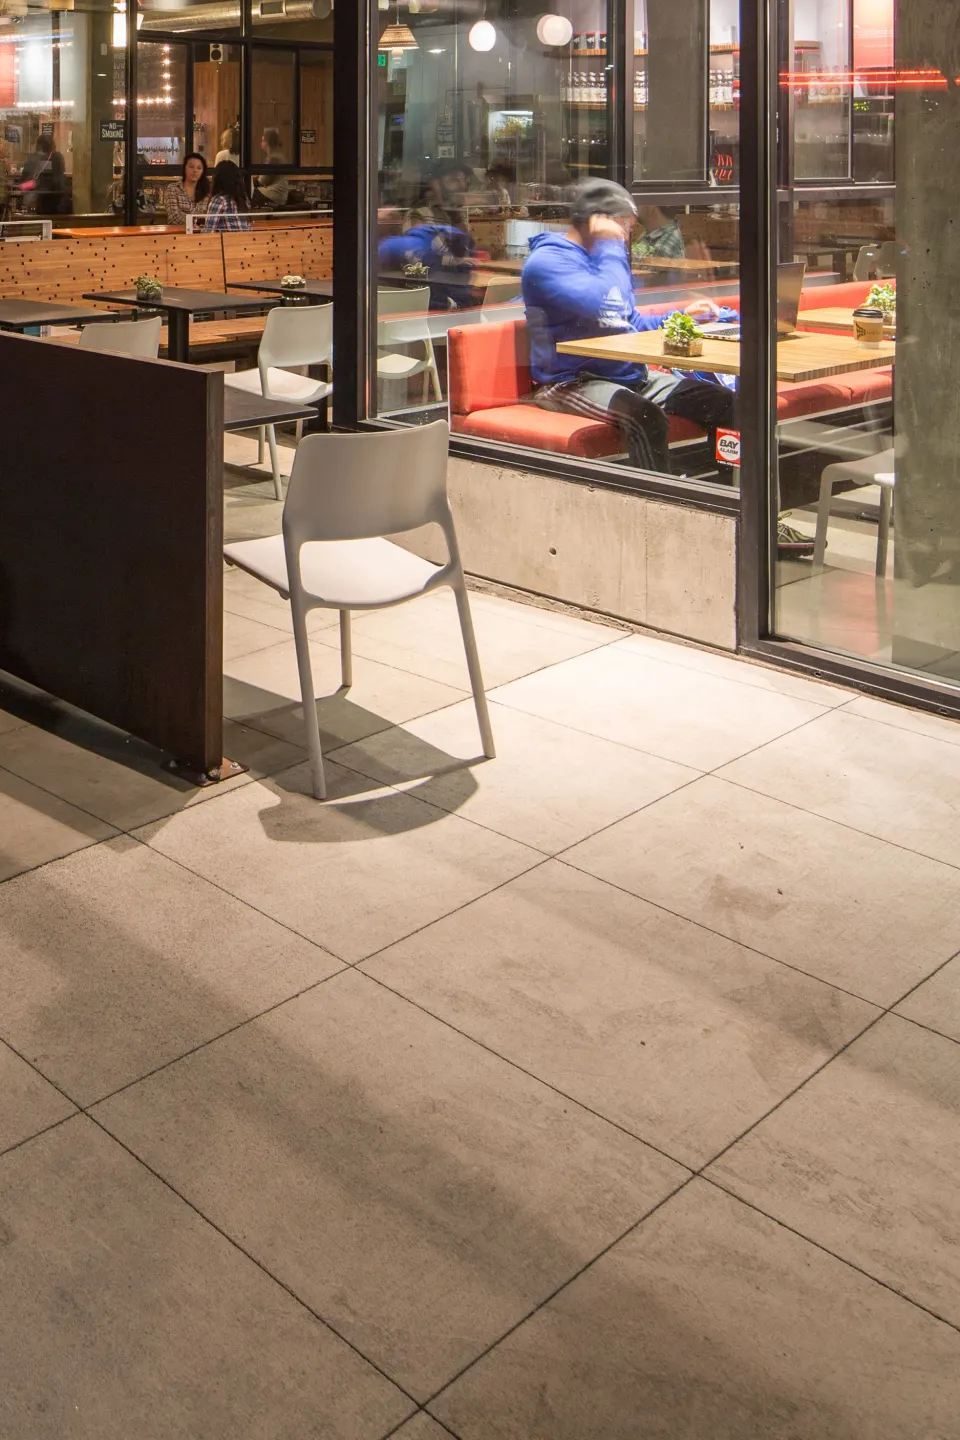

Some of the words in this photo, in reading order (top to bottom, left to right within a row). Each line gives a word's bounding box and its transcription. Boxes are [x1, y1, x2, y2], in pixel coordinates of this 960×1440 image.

[109, 122, 117, 130] NO
[101, 128, 124, 139] SMOKING
[719, 438, 739, 450] BAY
[719, 447, 739, 456] ALARM
